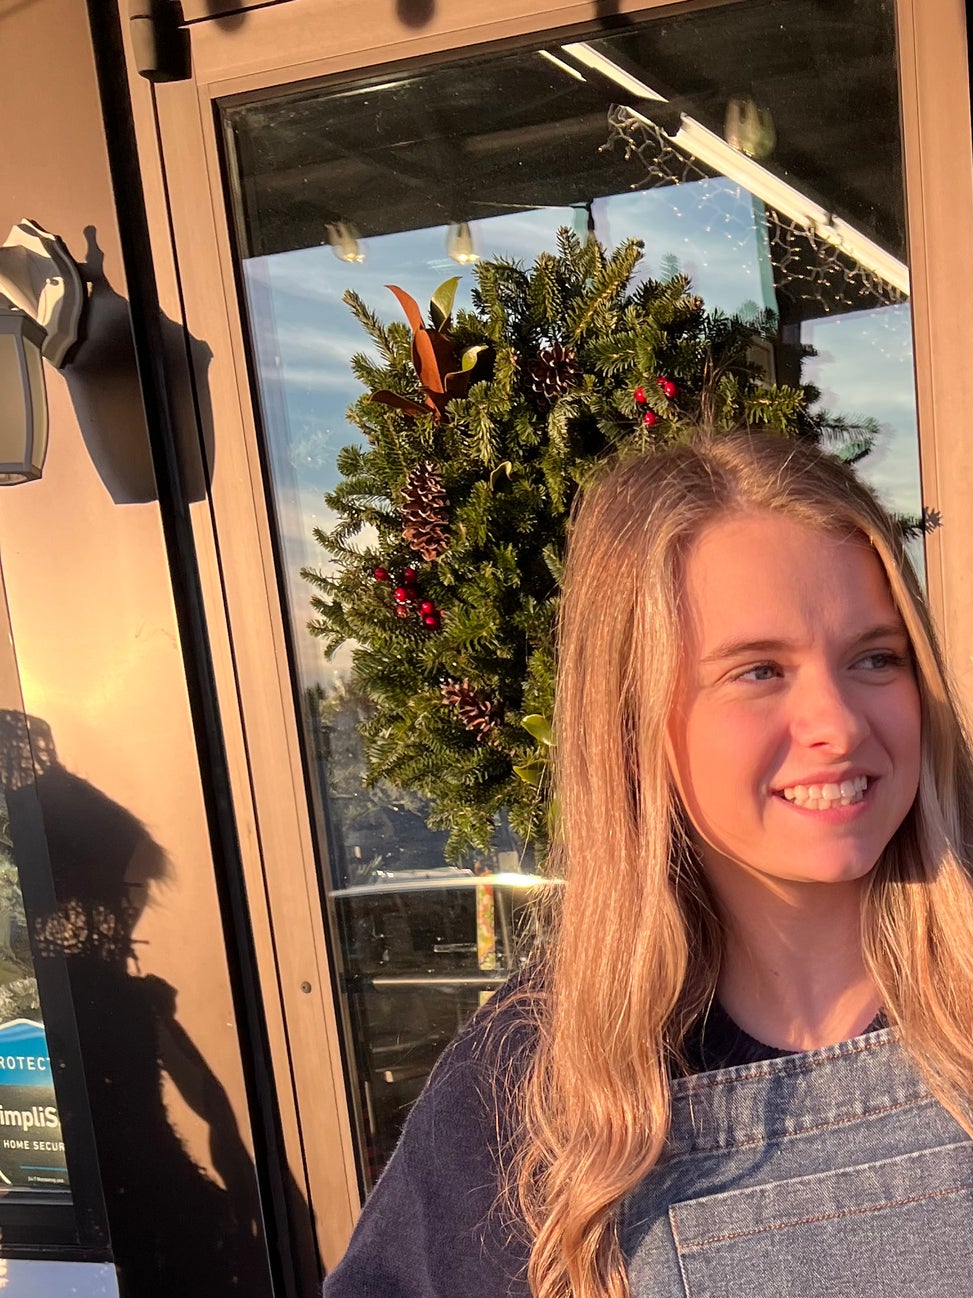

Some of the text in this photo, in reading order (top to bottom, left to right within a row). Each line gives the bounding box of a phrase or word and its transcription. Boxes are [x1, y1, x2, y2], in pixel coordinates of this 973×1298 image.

[0, 1056, 50, 1071] ROTEC
[0, 1105, 61, 1131] impliS
[3, 1139, 30, 1150] HOME
